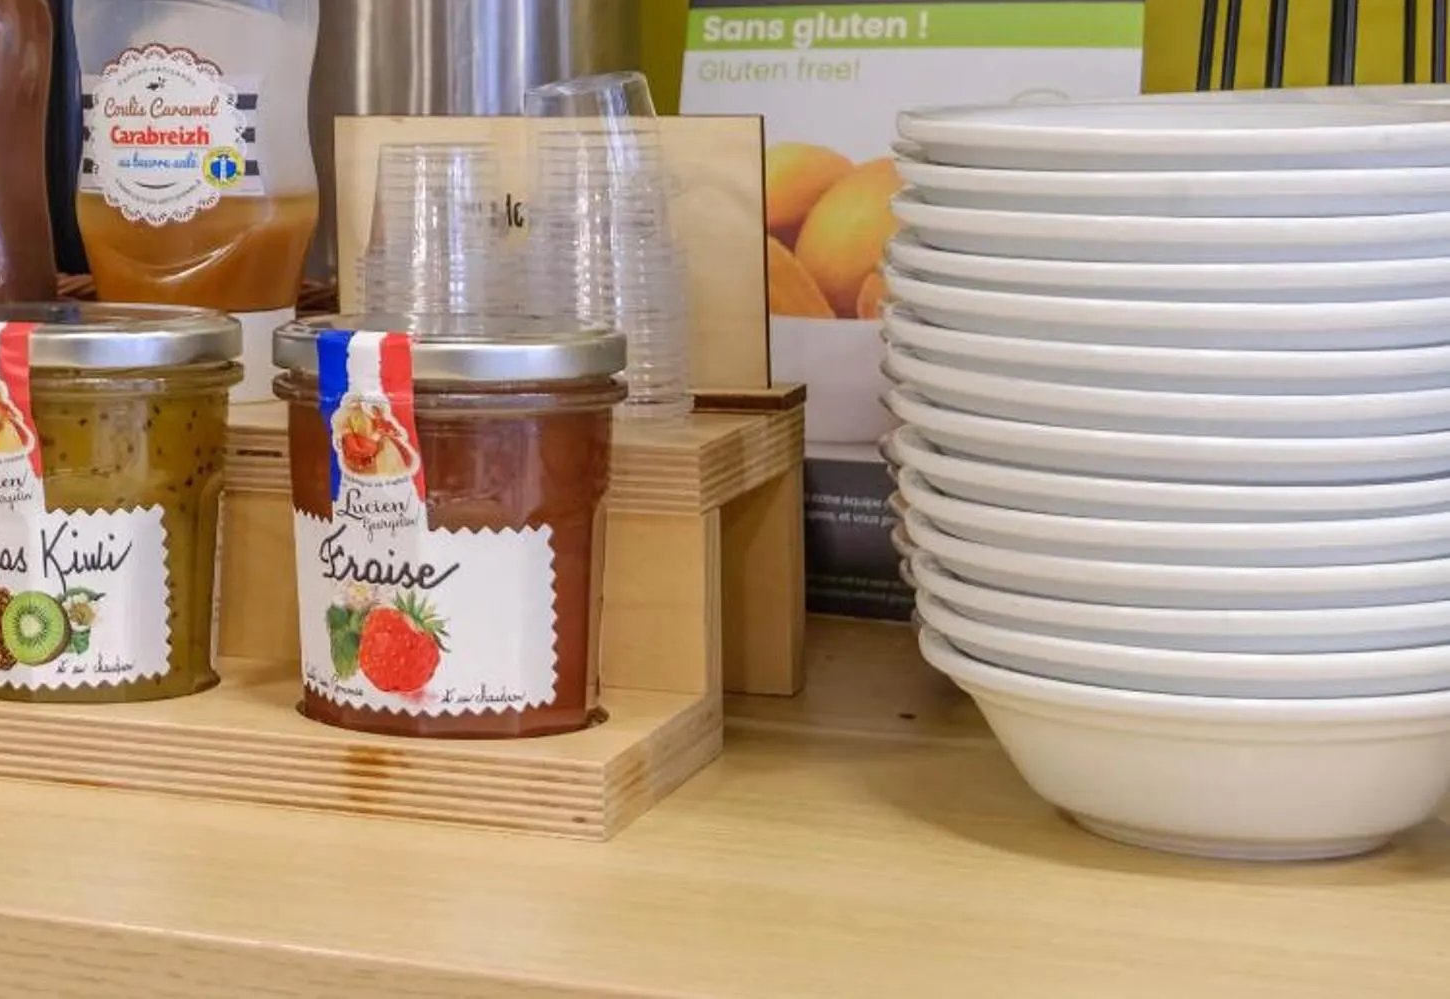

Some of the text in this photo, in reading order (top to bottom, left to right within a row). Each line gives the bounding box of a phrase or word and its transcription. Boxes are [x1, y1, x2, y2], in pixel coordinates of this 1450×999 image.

[703, 11, 929, 49] Sans gluten !
[698, 56, 861, 83] Gluten free!
[150, 95, 221, 119] Caramel
[110, 125, 211, 146] Carabreizh
[336, 489, 411, 521] Lucien
[40, 521, 133, 598] Kiwi
[319, 523, 461, 590] Fraise
